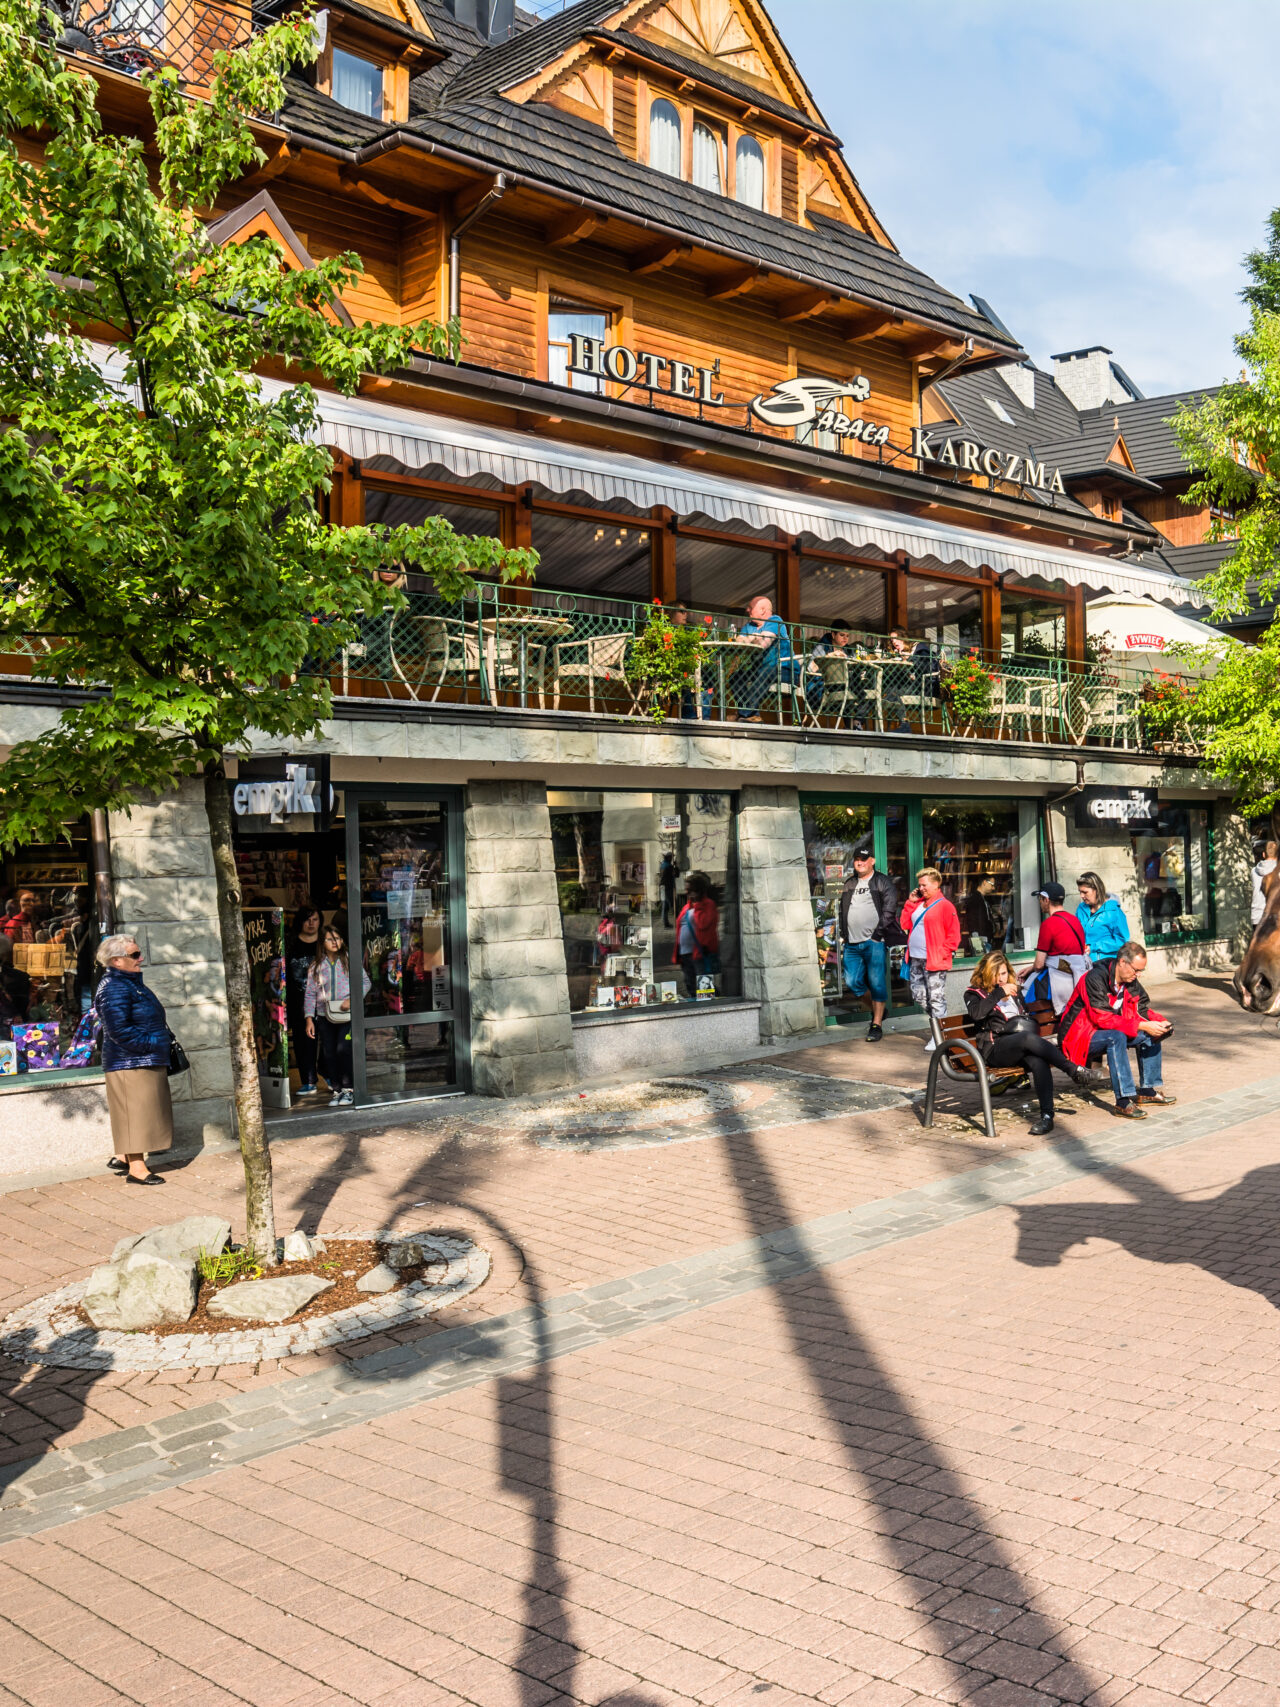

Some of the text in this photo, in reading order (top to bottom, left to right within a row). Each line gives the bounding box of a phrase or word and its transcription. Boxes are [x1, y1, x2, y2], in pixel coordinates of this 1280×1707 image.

[567, 333, 724, 405] HOTEL
[911, 428, 1066, 494] KARCZMA
[1129, 634, 1162, 645] ŻYWIEC
[234, 764, 321, 823] empik
[1088, 790, 1152, 823] empik
